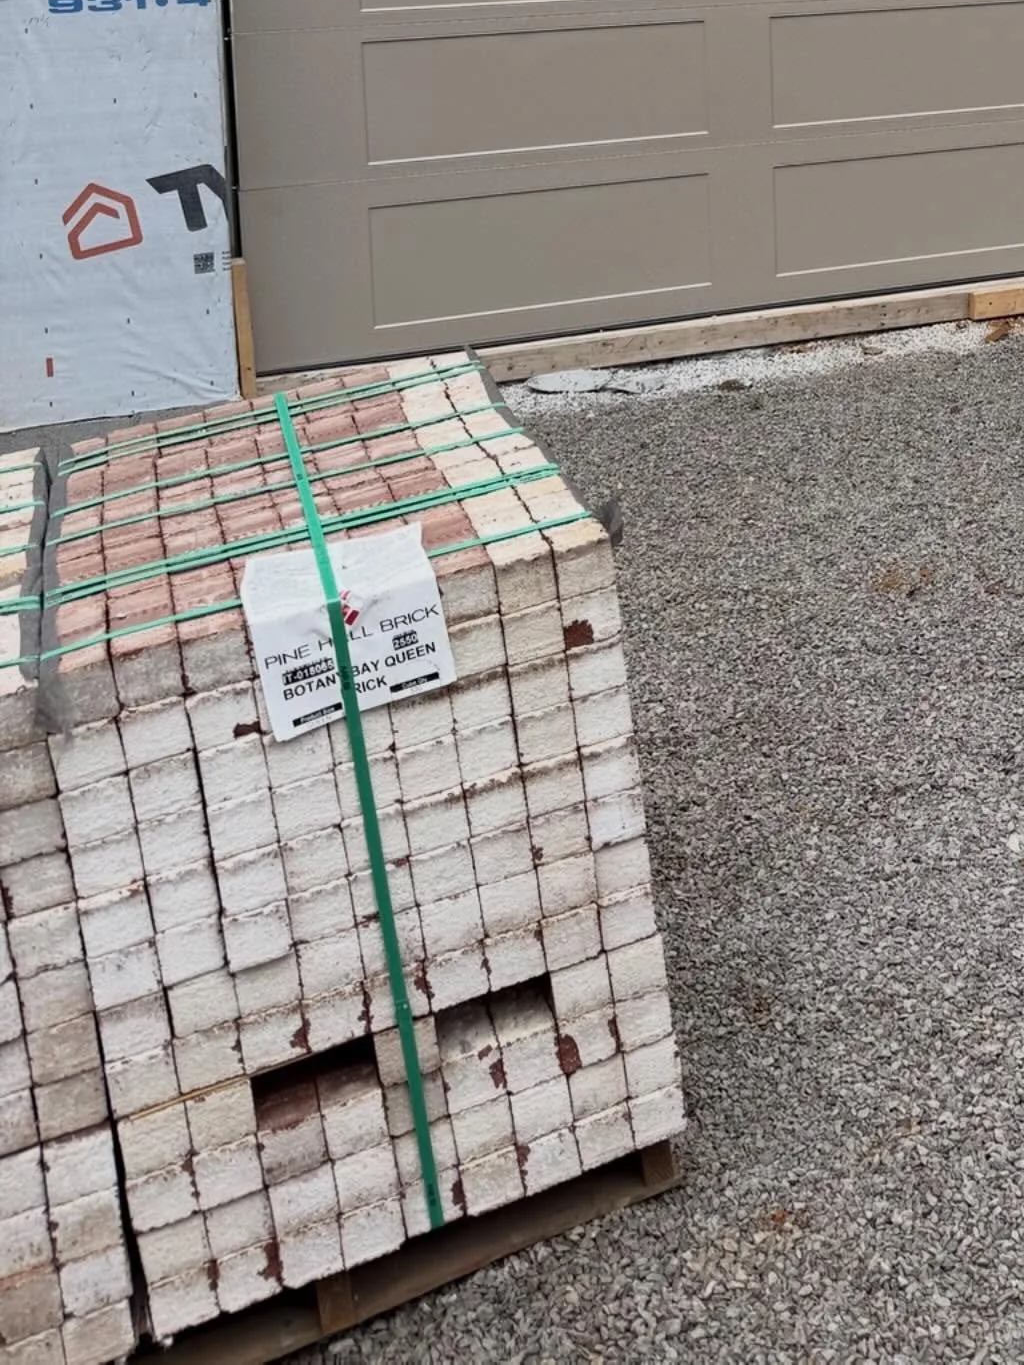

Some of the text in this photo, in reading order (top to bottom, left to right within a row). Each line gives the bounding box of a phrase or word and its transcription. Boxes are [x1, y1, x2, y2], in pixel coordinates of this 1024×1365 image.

[264, 604, 440, 670] PINE HLL BRICK
[384, 641, 436, 668] QUEEN
[355, 675, 388, 694] RICK
